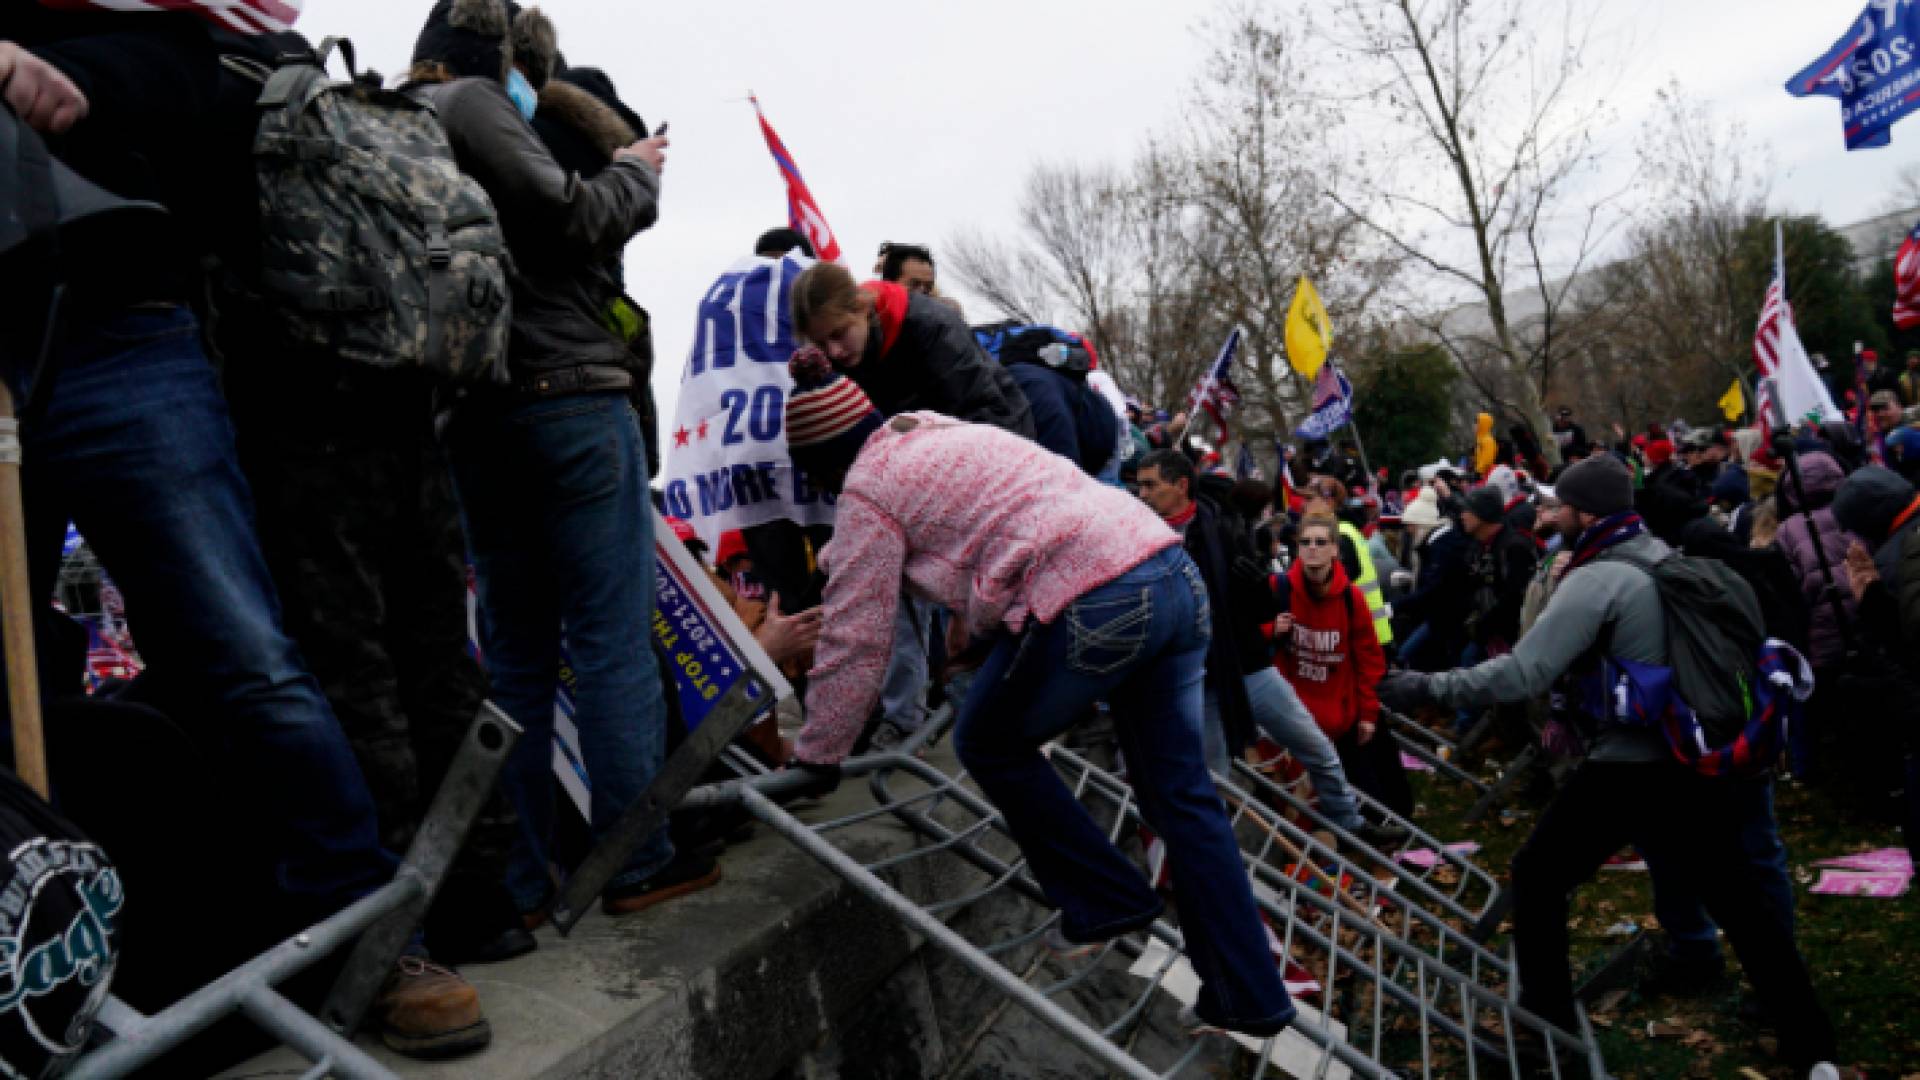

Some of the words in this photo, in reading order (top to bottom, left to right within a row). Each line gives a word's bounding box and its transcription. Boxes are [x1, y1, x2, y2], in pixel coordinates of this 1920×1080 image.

[691, 256, 799, 375] RU
[719, 385, 784, 446] 20
[676, 652, 718, 699] STOP
